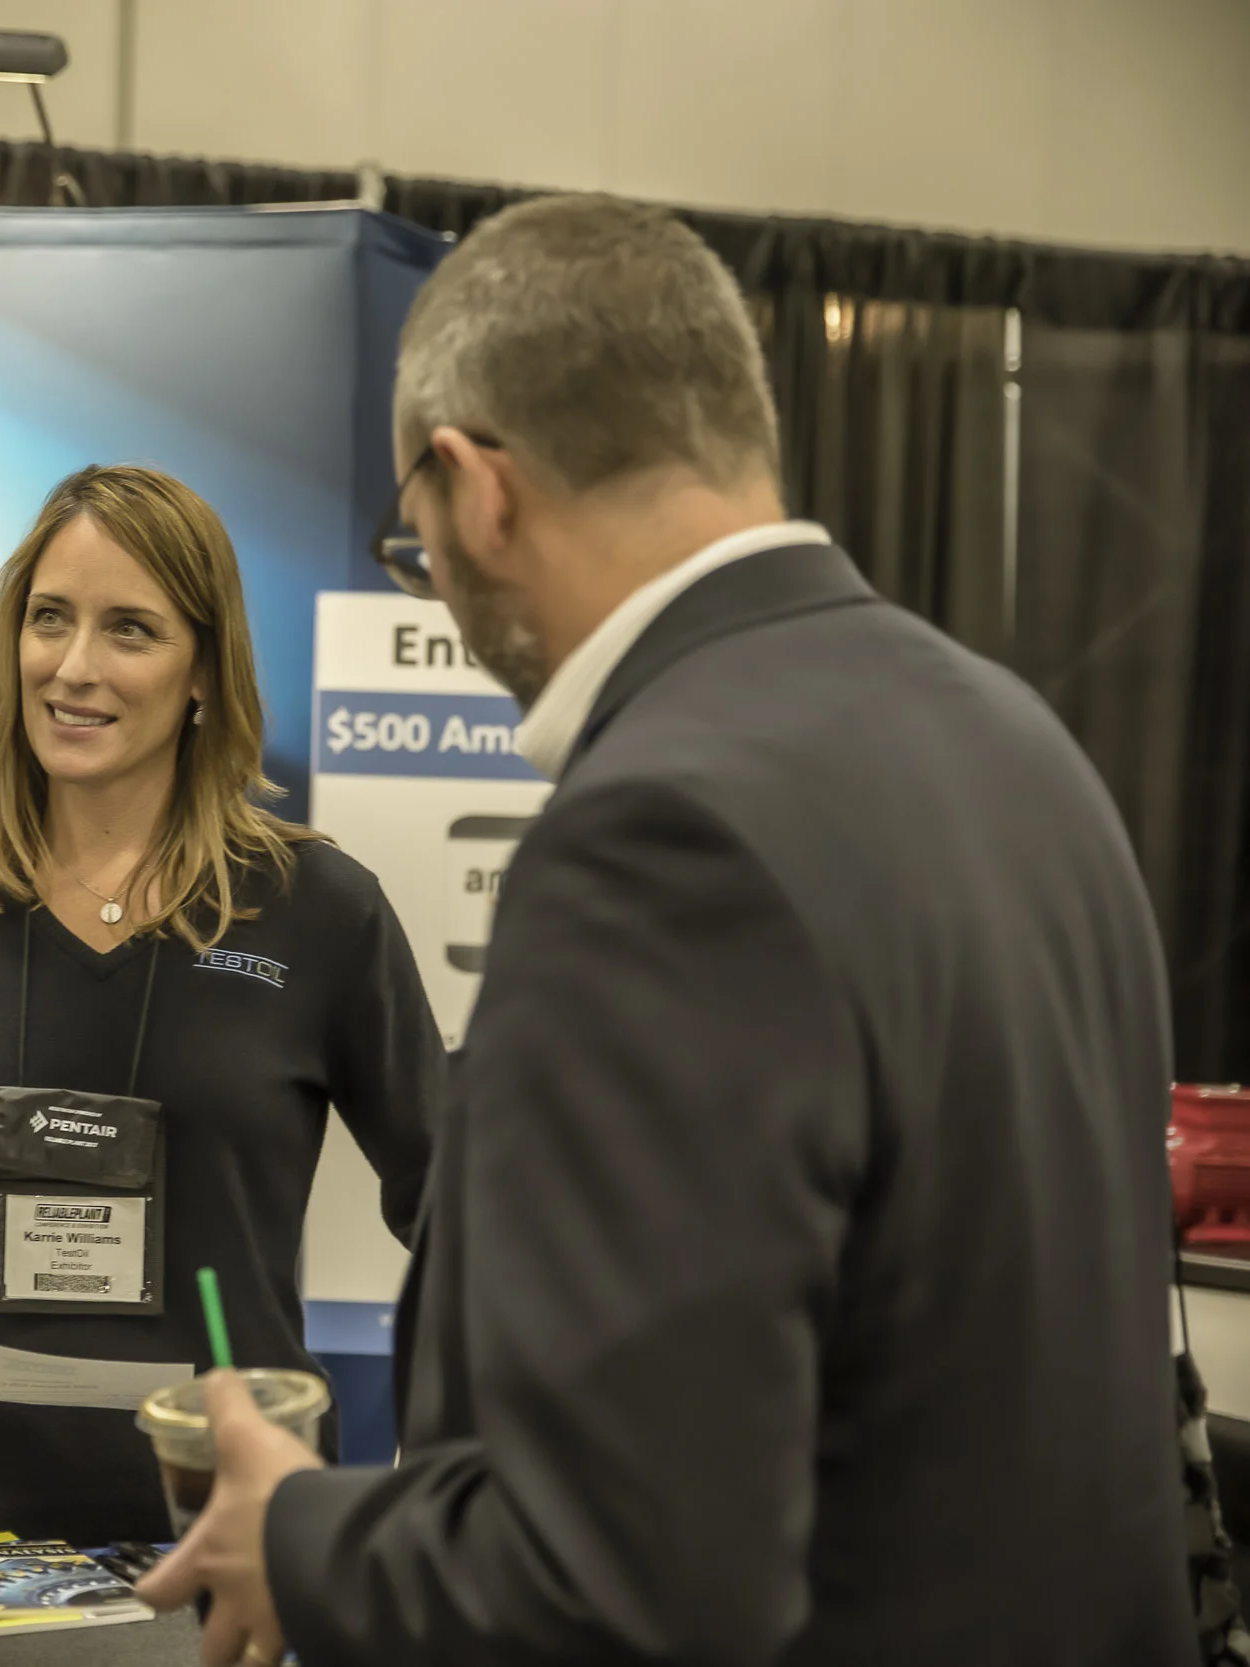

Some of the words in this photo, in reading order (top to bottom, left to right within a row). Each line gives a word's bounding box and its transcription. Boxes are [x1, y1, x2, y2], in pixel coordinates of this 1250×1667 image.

[326, 706, 431, 755] $500
[49, 1118, 118, 1138] PENTAIR
[67, 1232, 122, 1245] Williams
